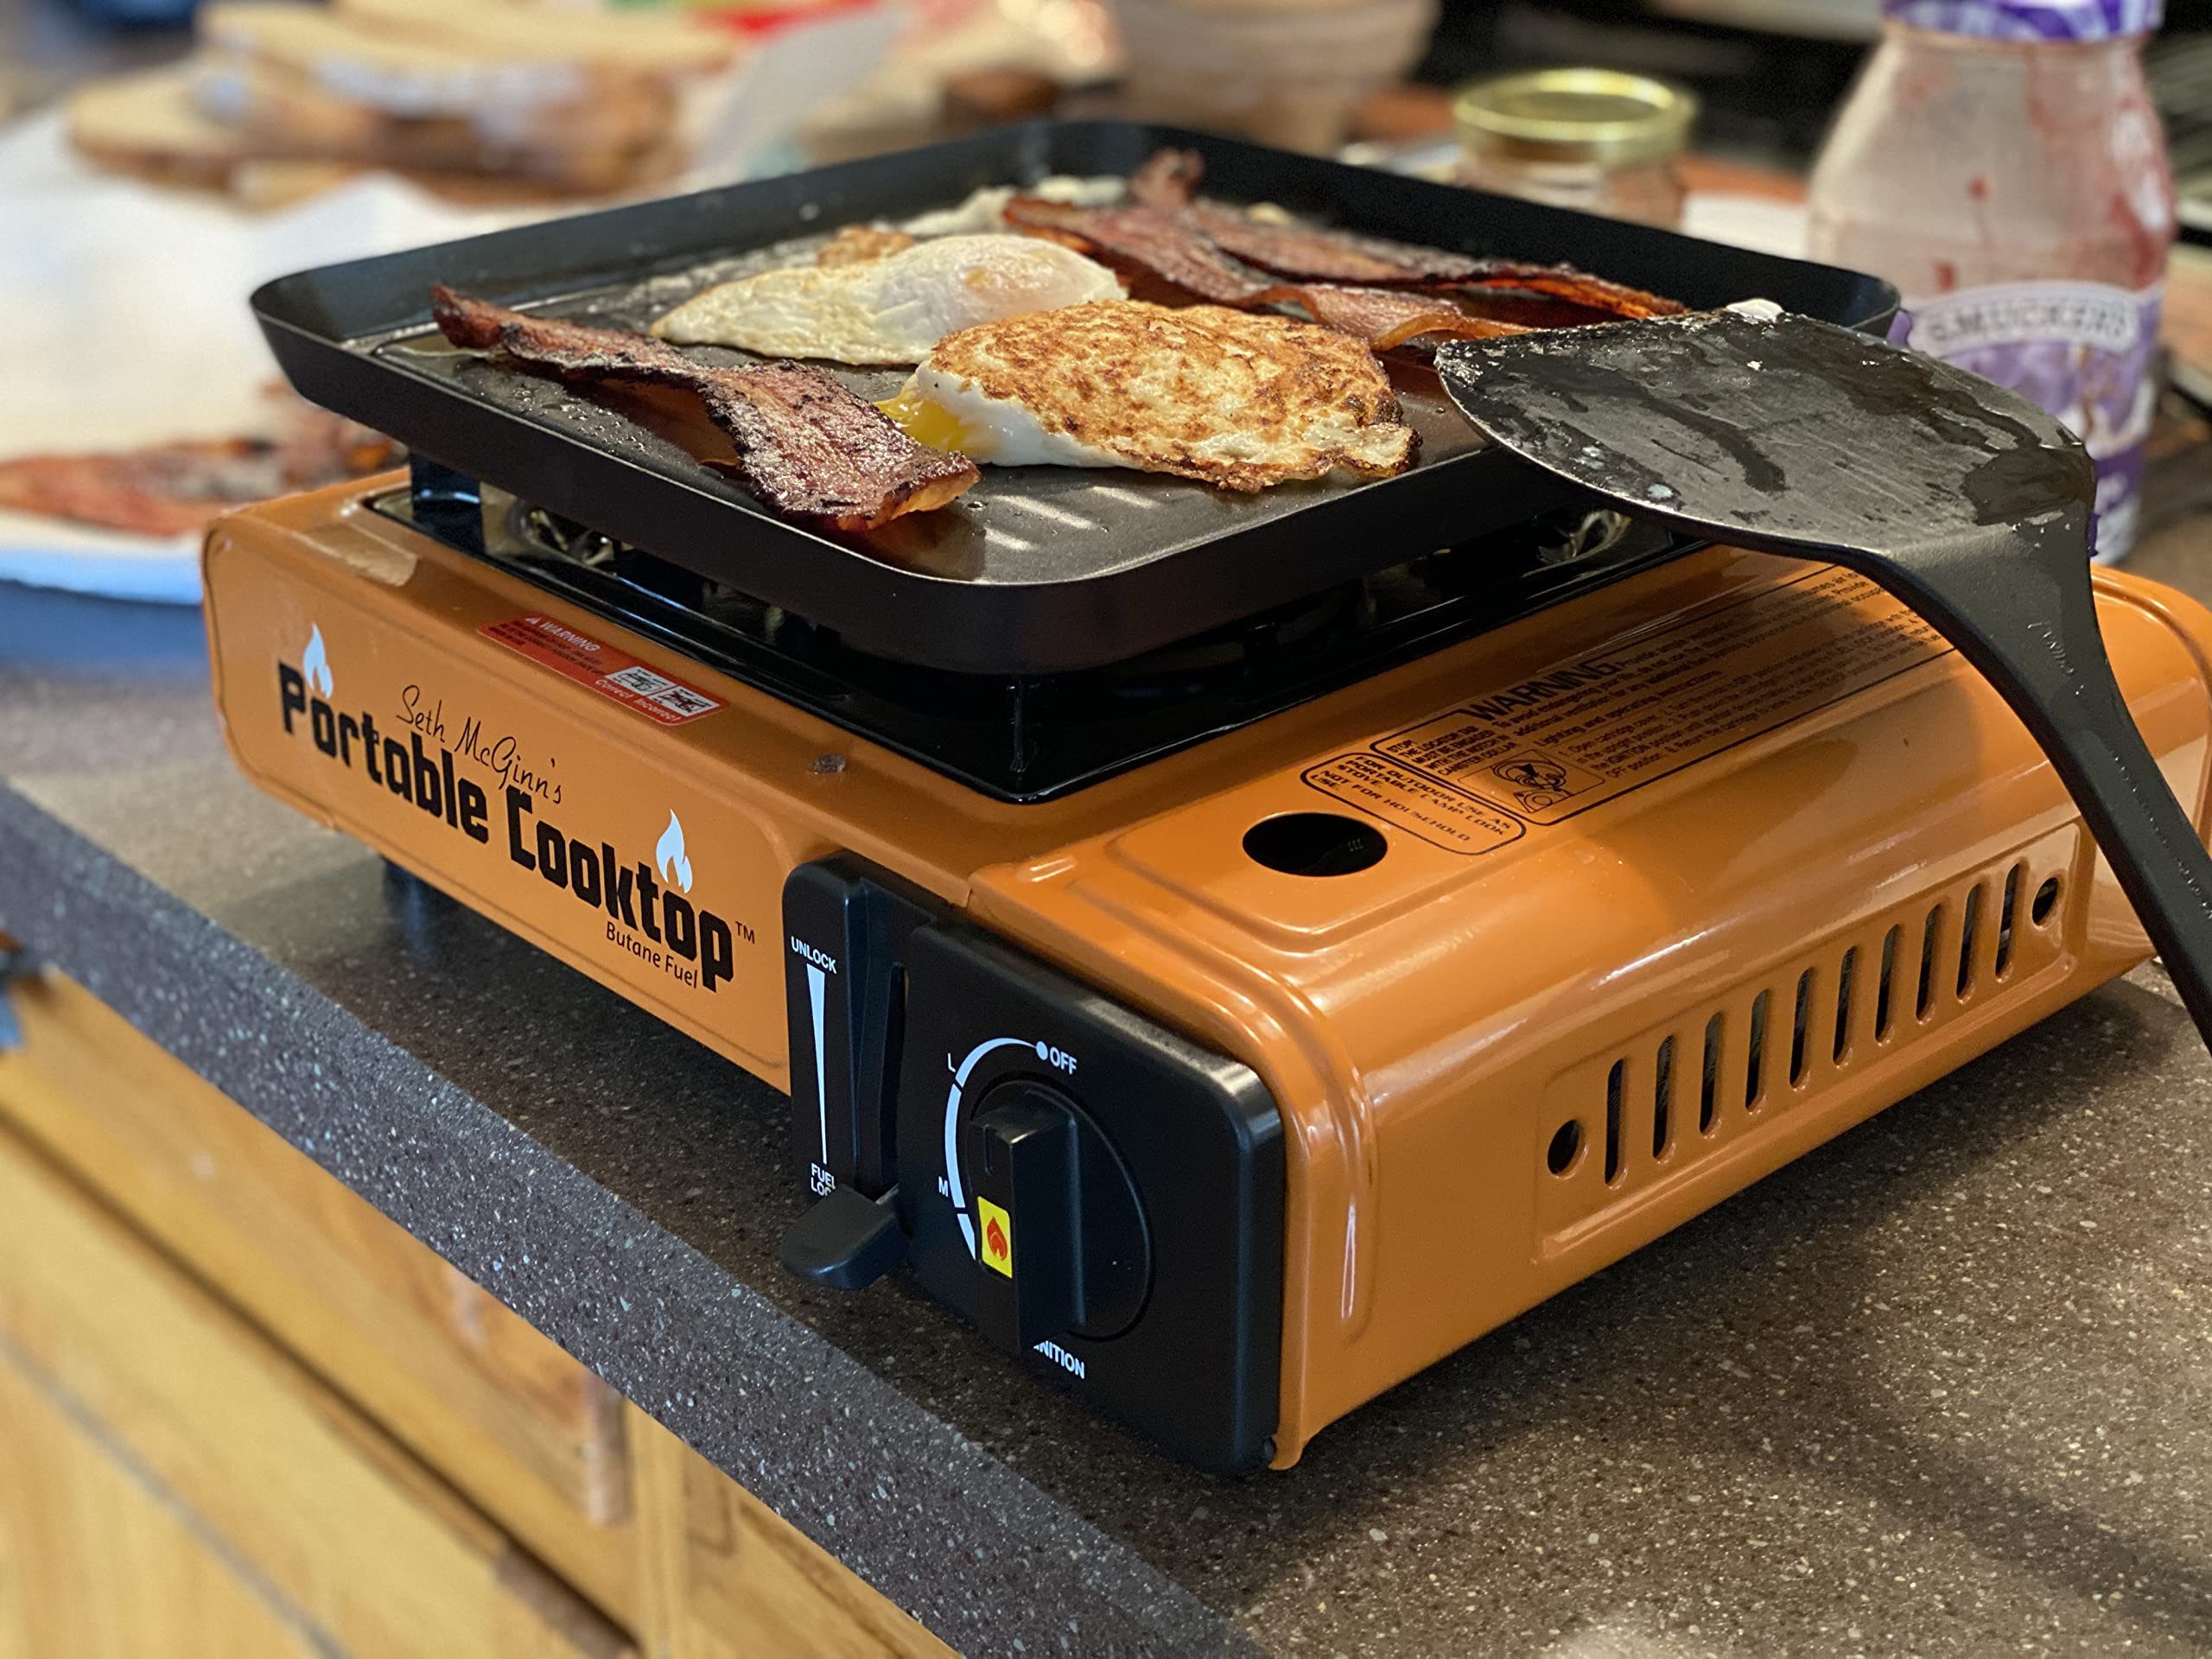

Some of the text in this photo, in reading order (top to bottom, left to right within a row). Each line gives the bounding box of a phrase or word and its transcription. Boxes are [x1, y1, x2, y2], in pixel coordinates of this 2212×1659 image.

[539, 621, 600, 651] WARNING
[594, 679, 680, 721] Correct Incorrect
[1468, 659, 1623, 721] WARNING
[396, 684, 563, 804] Seth McGinn's
[1398, 725, 1478, 757] THE LOCATOR TAB
[1412, 751, 1439, 763] MUST
[1450, 729, 1494, 747] ENGAGED
[1534, 726, 1586, 746] Lighting
[1584, 715, 1605, 727] and
[1425, 758, 1450, 769] WITH
[1466, 739, 1499, 753] NOTCH
[1438, 756, 1483, 775] CANISTER
[1320, 770, 1470, 840] NOT FOR HOUSEHOLD
[1345, 760, 1417, 793] PORTABLE
[1465, 815, 1503, 835] COOK
[1355, 756, 1510, 829] FOR OUTDOOR USE AS
[277, 660, 489, 844] Portable
[505, 784, 734, 994] Cooktop
[605, 920, 698, 989] Butane Fuel
[790, 936, 837, 975] UNLOCK
[1049, 1046, 1077, 1075] OFF
[810, 1162, 836, 1190] FUEL
[938, 1176, 950, 1198] M
[1033, 1340, 1085, 1380] NITION
